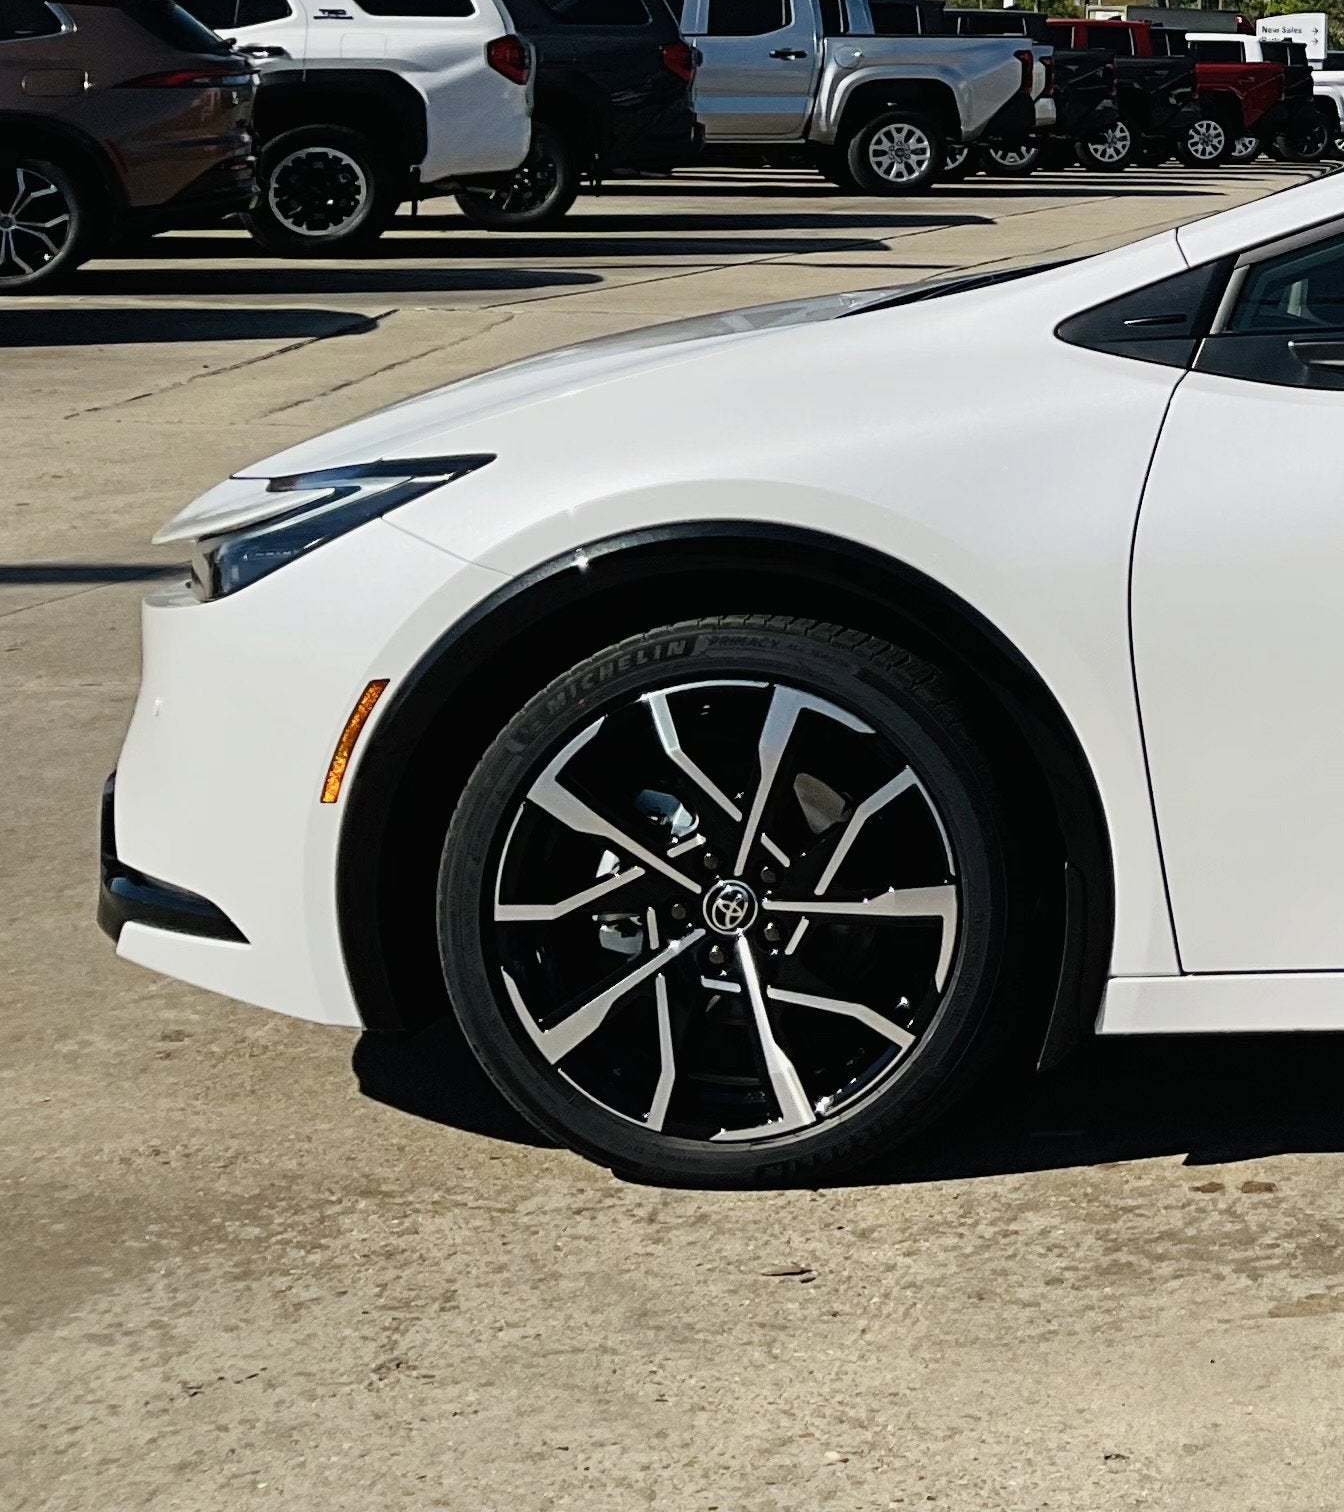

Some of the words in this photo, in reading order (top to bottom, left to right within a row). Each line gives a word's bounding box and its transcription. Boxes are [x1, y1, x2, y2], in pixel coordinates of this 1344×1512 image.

[1261, 25, 1280, 34] New
[1281, 25, 1303, 34] Sales
[546, 639, 687, 715] MICHELIN
